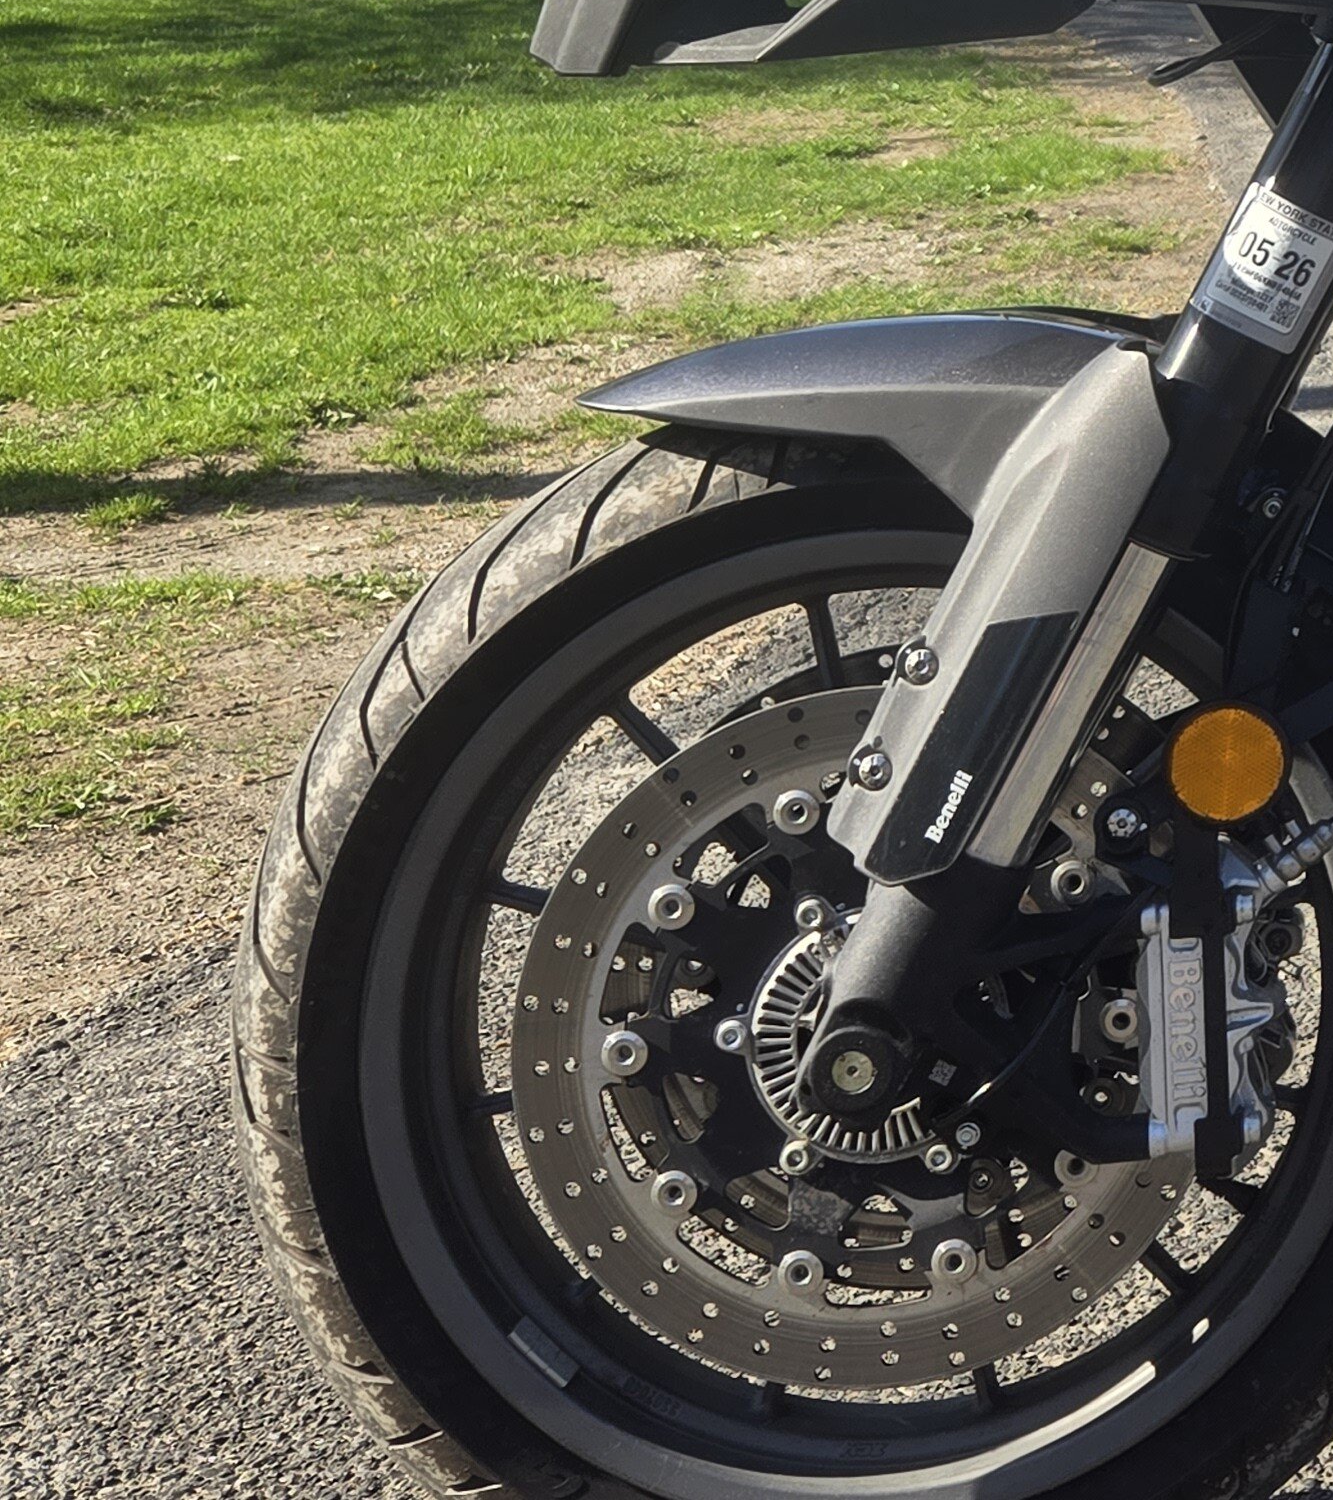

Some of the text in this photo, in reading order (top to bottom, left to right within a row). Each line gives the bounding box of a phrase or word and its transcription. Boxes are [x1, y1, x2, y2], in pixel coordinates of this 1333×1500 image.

[1277, 201, 1309, 223] YORK
[1238, 231, 1317, 288] 05-26
[923, 769, 973, 844] Benelli
[1168, 958, 1206, 1105] Benelli
